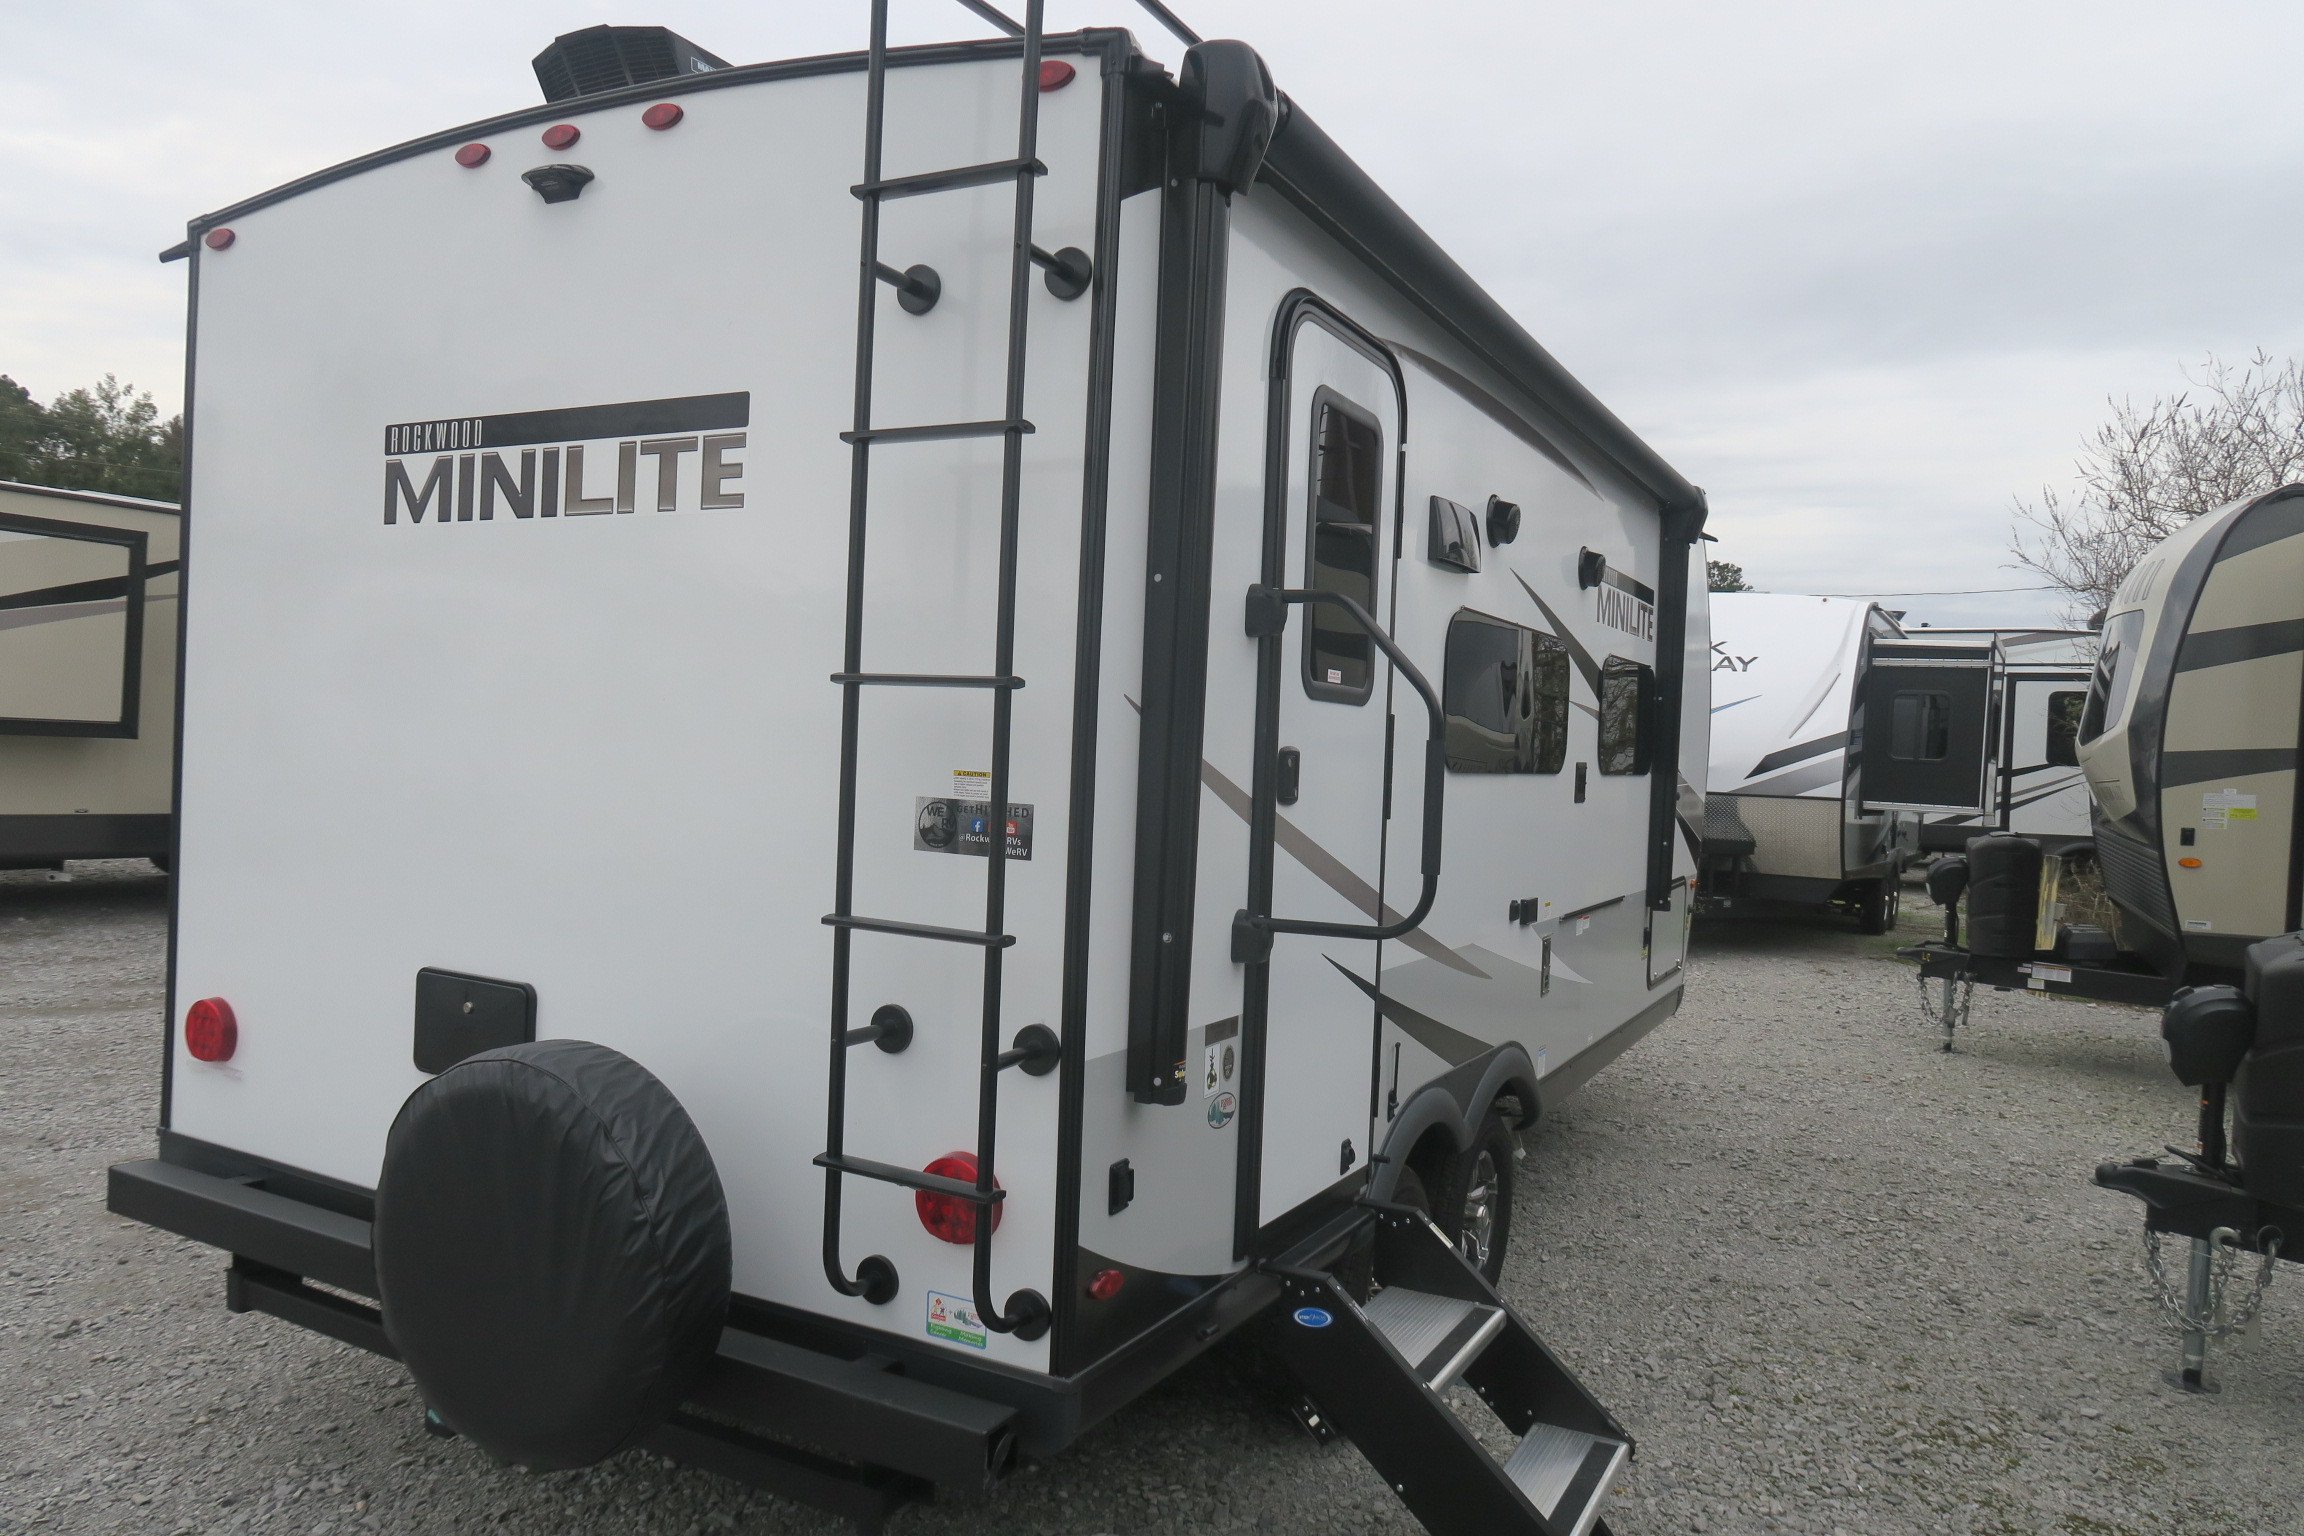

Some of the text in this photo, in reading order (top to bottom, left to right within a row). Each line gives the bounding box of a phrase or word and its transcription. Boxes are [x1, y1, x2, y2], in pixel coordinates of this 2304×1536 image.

[391, 419, 483, 453] ROCKWOOD
[384, 432, 747, 524] MINILITE
[1596, 585, 1653, 642] MINILITE
[926, 805, 945, 817] WE
